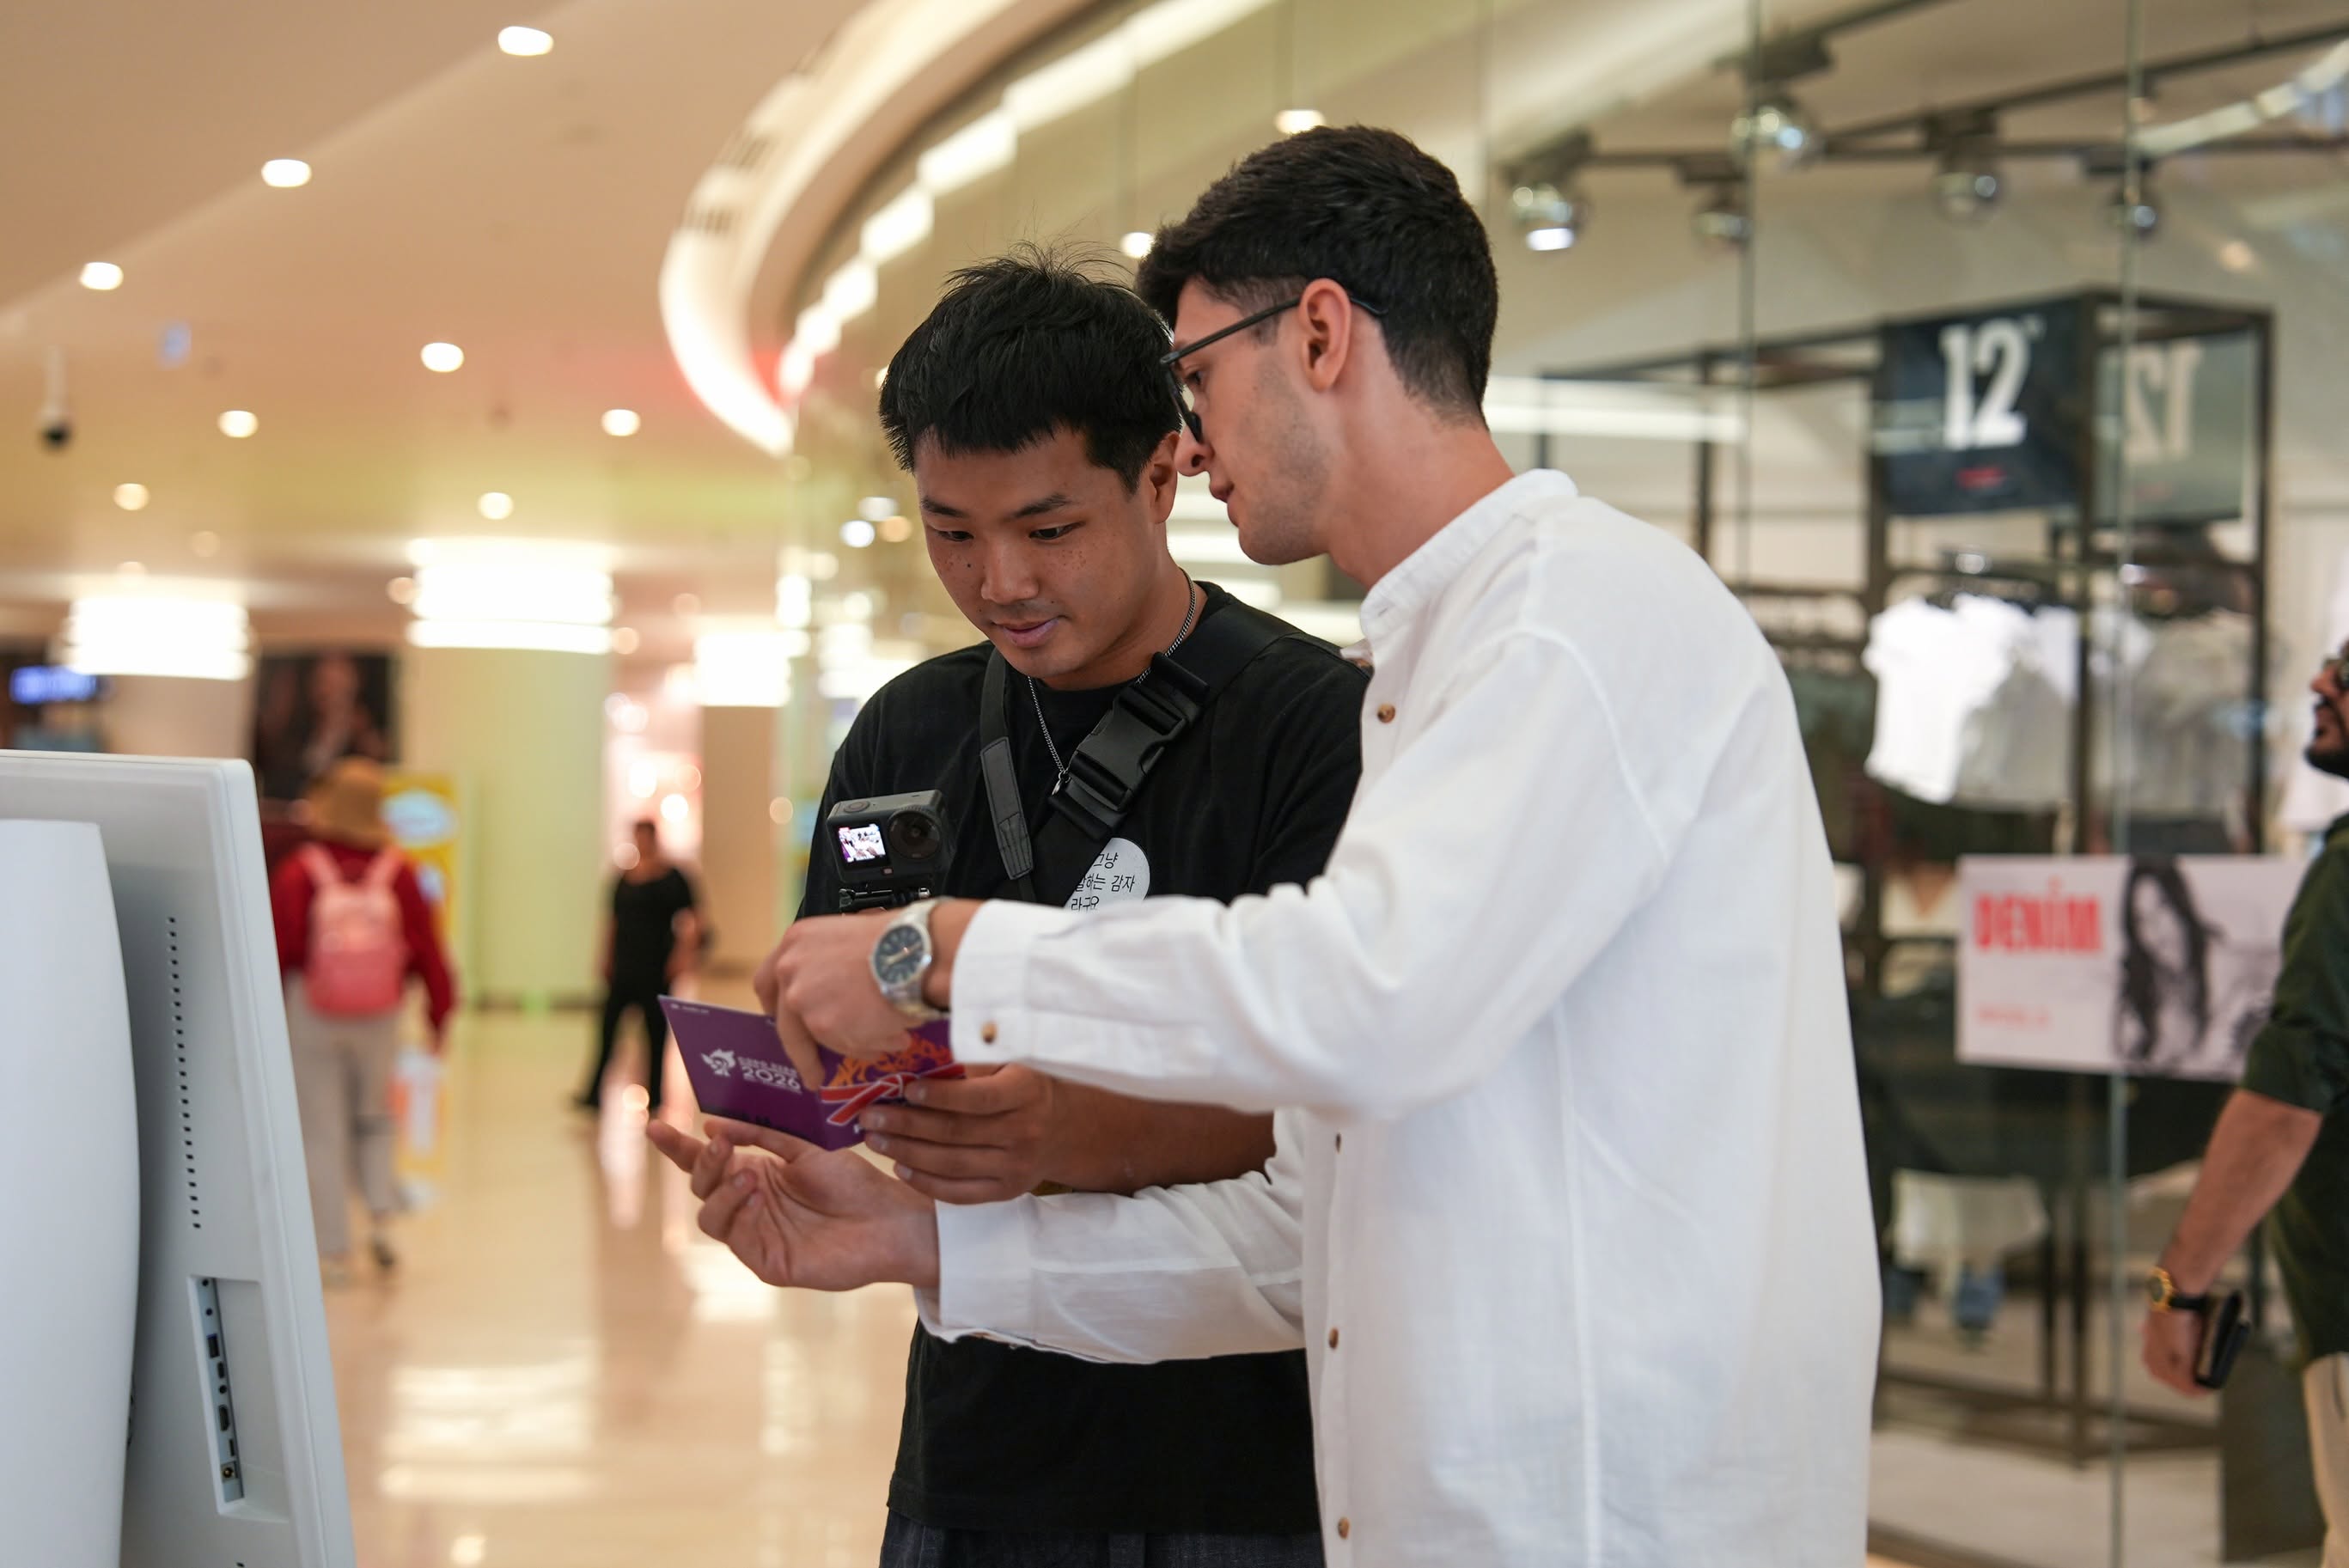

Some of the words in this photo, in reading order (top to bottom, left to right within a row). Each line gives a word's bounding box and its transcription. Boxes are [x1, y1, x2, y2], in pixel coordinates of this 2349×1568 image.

[1939, 318, 2031, 450] 12
[1093, 852, 1119, 869] 그냥
[1111, 875, 1135, 893] 감자
[1071, 896, 1100, 912] 라구요
[741, 1065, 801, 1090] 2026
